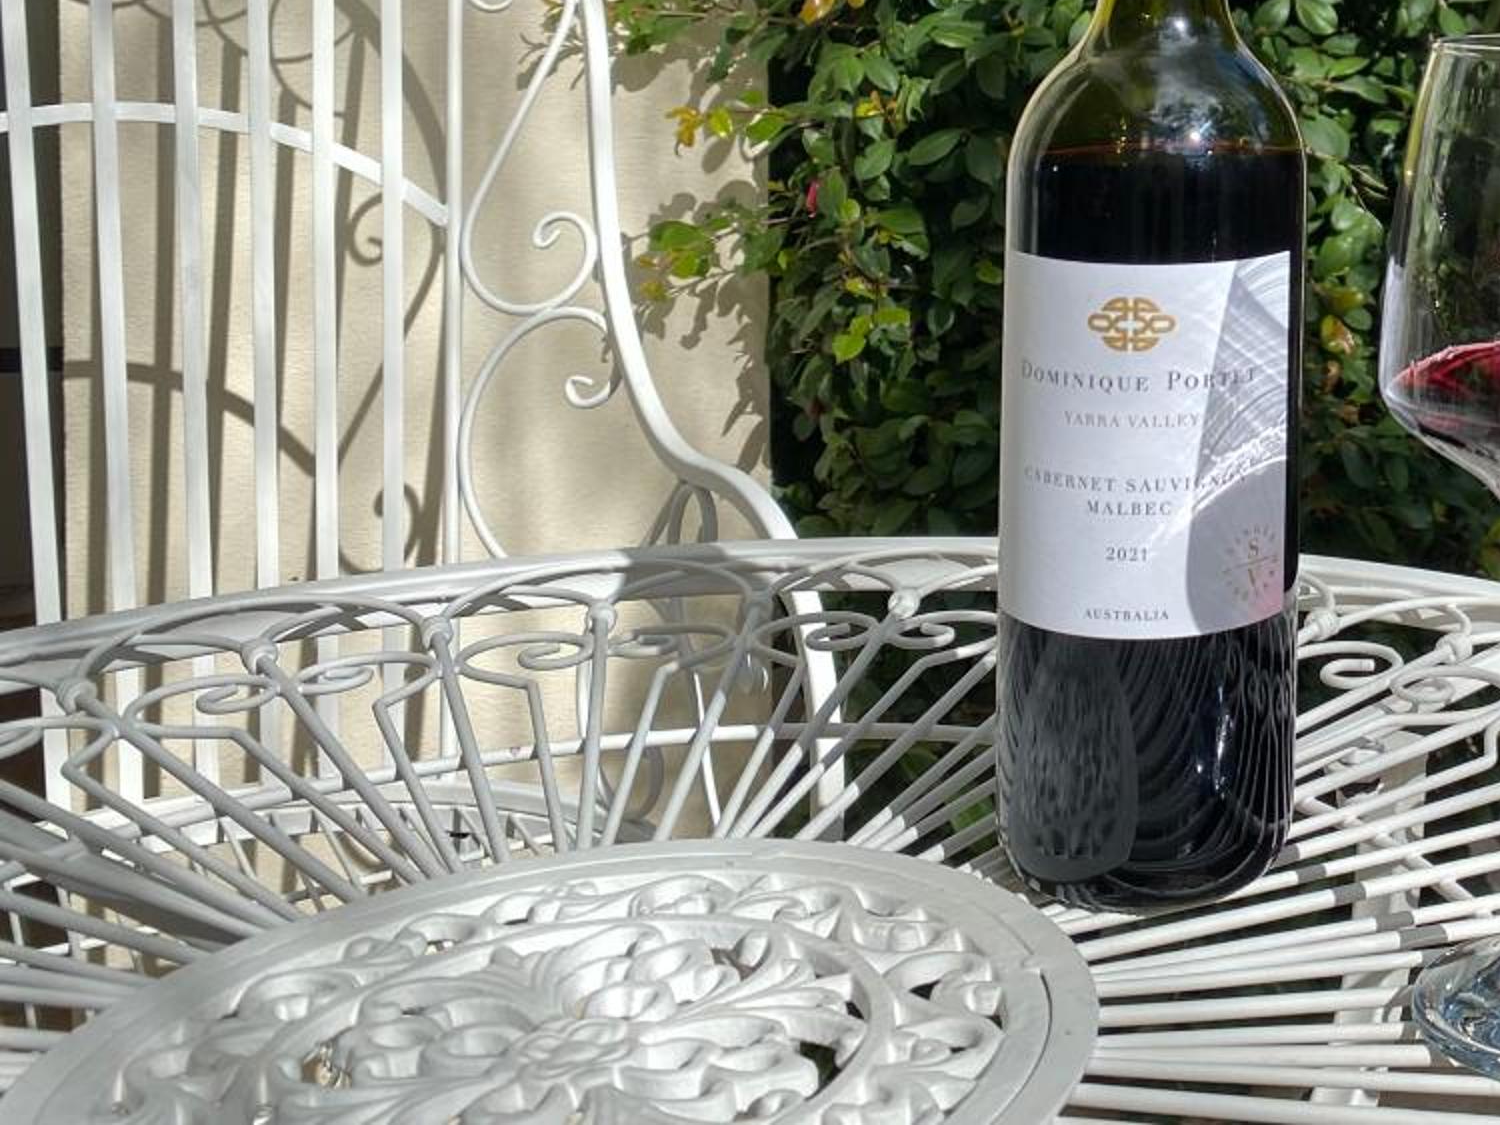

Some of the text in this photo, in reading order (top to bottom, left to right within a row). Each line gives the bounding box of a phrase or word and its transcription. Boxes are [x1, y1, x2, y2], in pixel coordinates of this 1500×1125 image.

[1021, 359, 1149, 393] DOMINIQUE
[1063, 410, 1199, 428] YARRA VALLEY
[1023, 464, 1117, 492] CABERNET
[1087, 498, 1171, 516] MALBEC
[1104, 546, 1147, 562] 2021
[1083, 607, 1169, 622] AUSTRALIA
